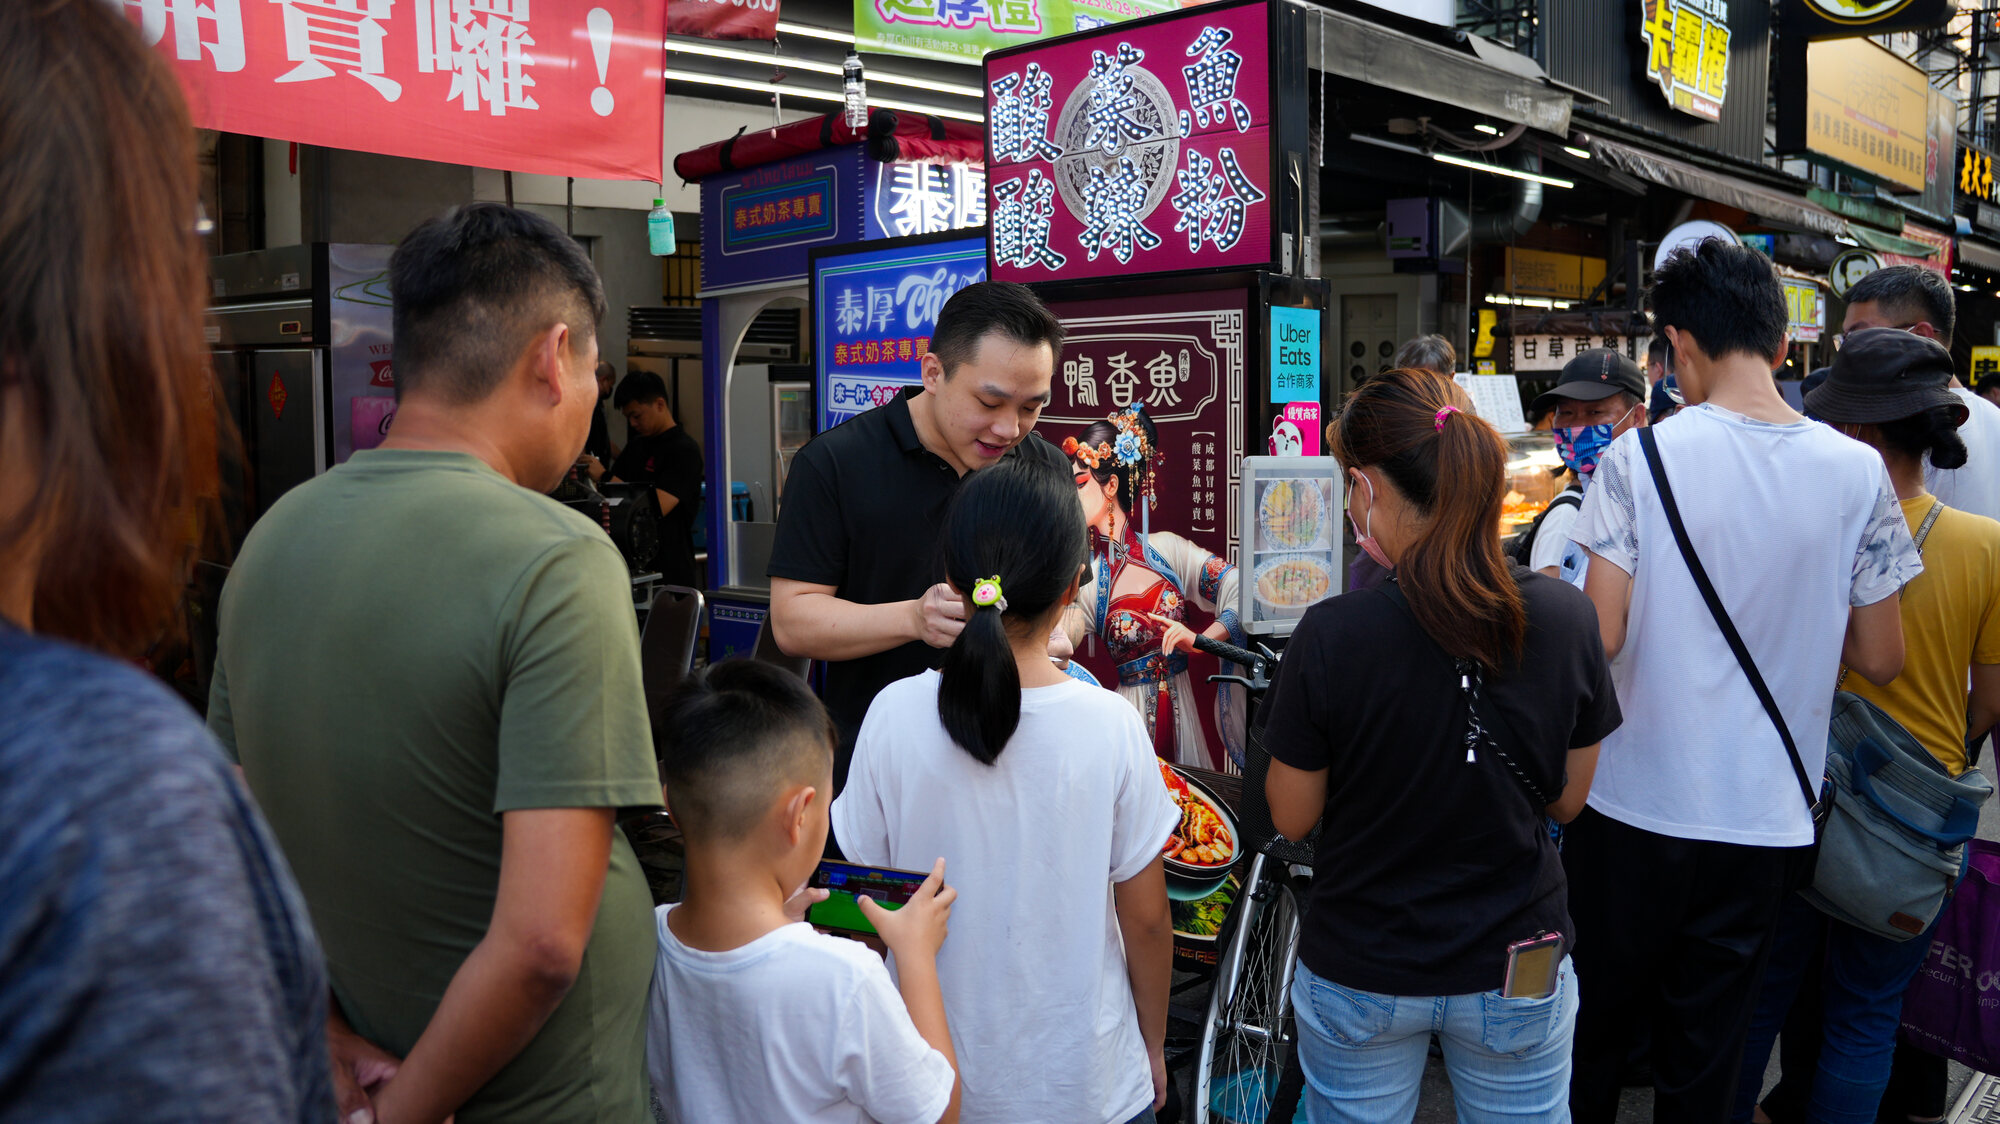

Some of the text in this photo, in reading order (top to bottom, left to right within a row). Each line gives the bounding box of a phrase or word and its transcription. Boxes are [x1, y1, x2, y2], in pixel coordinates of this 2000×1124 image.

[991, 27, 1251, 162] 酸菜魚
[734, 193, 822, 231] 泰式奶茶專賣
[993, 148, 1266, 271] 酸辣粉
[834, 286, 896, 336] 泰厚
[833, 335, 931, 367] 泰式奶茶專賣
[1279, 323, 1311, 344] Uber
[1279, 346, 1311, 366] Eats
[1041, 350, 1182, 408] 鴨香魚
[1277, 373, 1315, 389] 合作商家
[1287, 406, 1318, 421] 優質商家
[1191, 442, 1202, 521] 酸菜魚專賣
